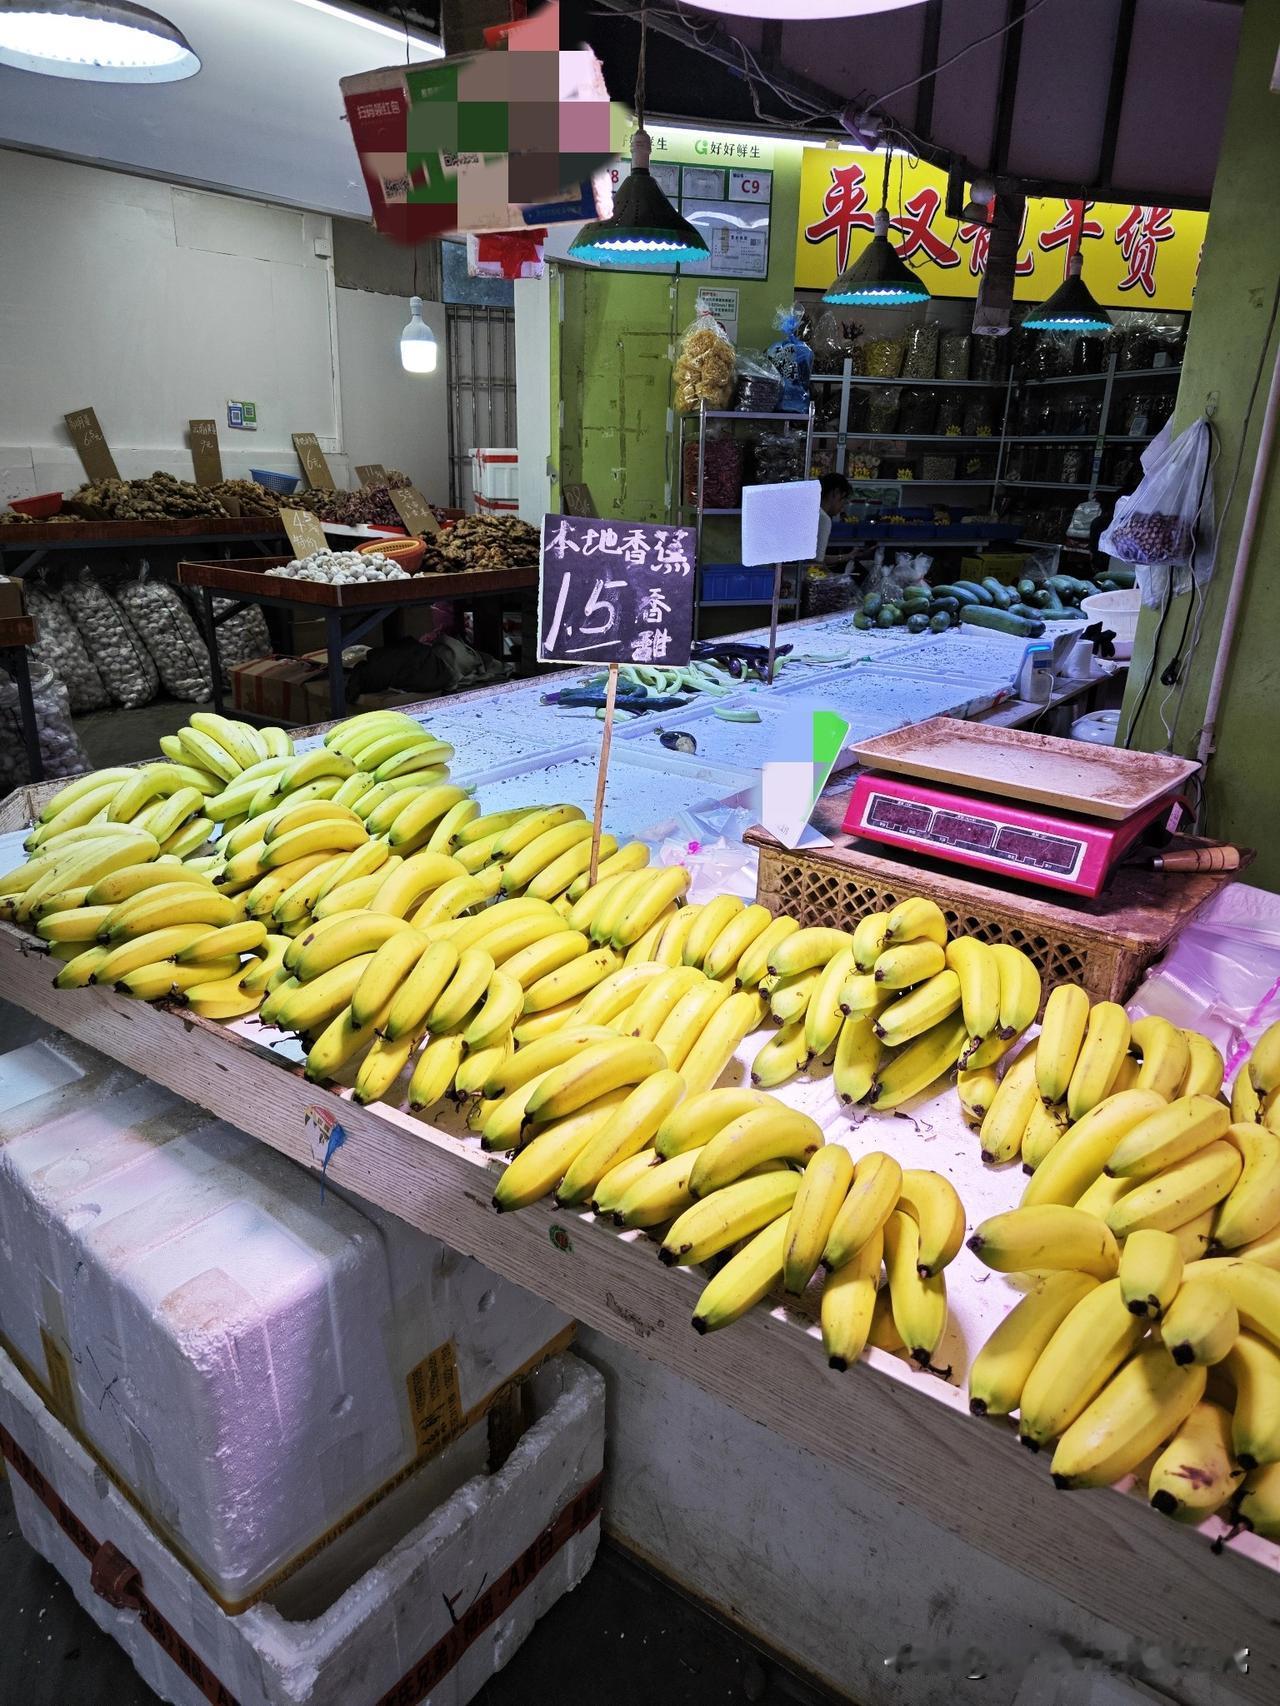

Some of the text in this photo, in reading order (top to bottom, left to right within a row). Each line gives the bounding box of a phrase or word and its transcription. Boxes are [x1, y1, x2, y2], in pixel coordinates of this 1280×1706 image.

[710, 141, 761, 158] 好好鲜生
[741, 179, 760, 194] C9
[545, 519, 691, 577] 本地香蕉
[543, 572, 629, 652] 1.5
